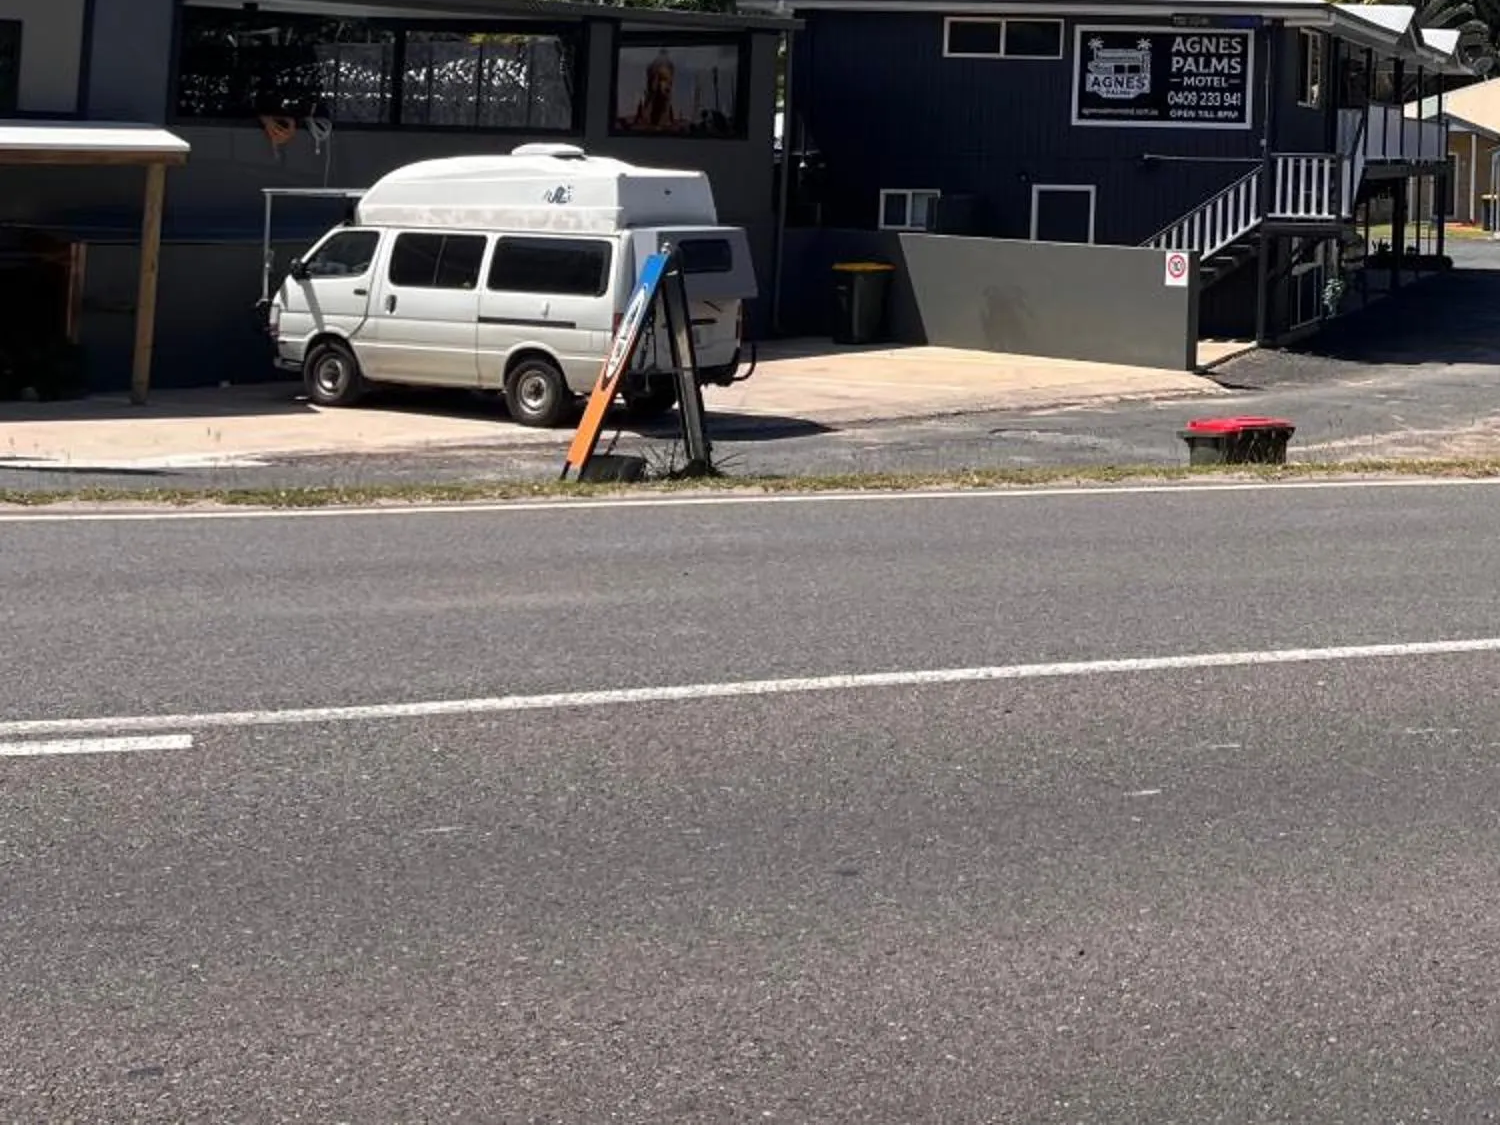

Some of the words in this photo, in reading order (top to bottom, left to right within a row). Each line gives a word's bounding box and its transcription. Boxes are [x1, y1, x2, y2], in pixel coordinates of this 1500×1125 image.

[1171, 36, 1242, 54] AGNES
[1171, 56, 1241, 74] PALMS
[1091, 76, 1146, 90] AGNES
[1183, 76, 1228, 87] MOTEL
[1199, 91, 1221, 106] 233
[1223, 92, 1241, 107] 941
[1169, 109, 1196, 118] OPEN
